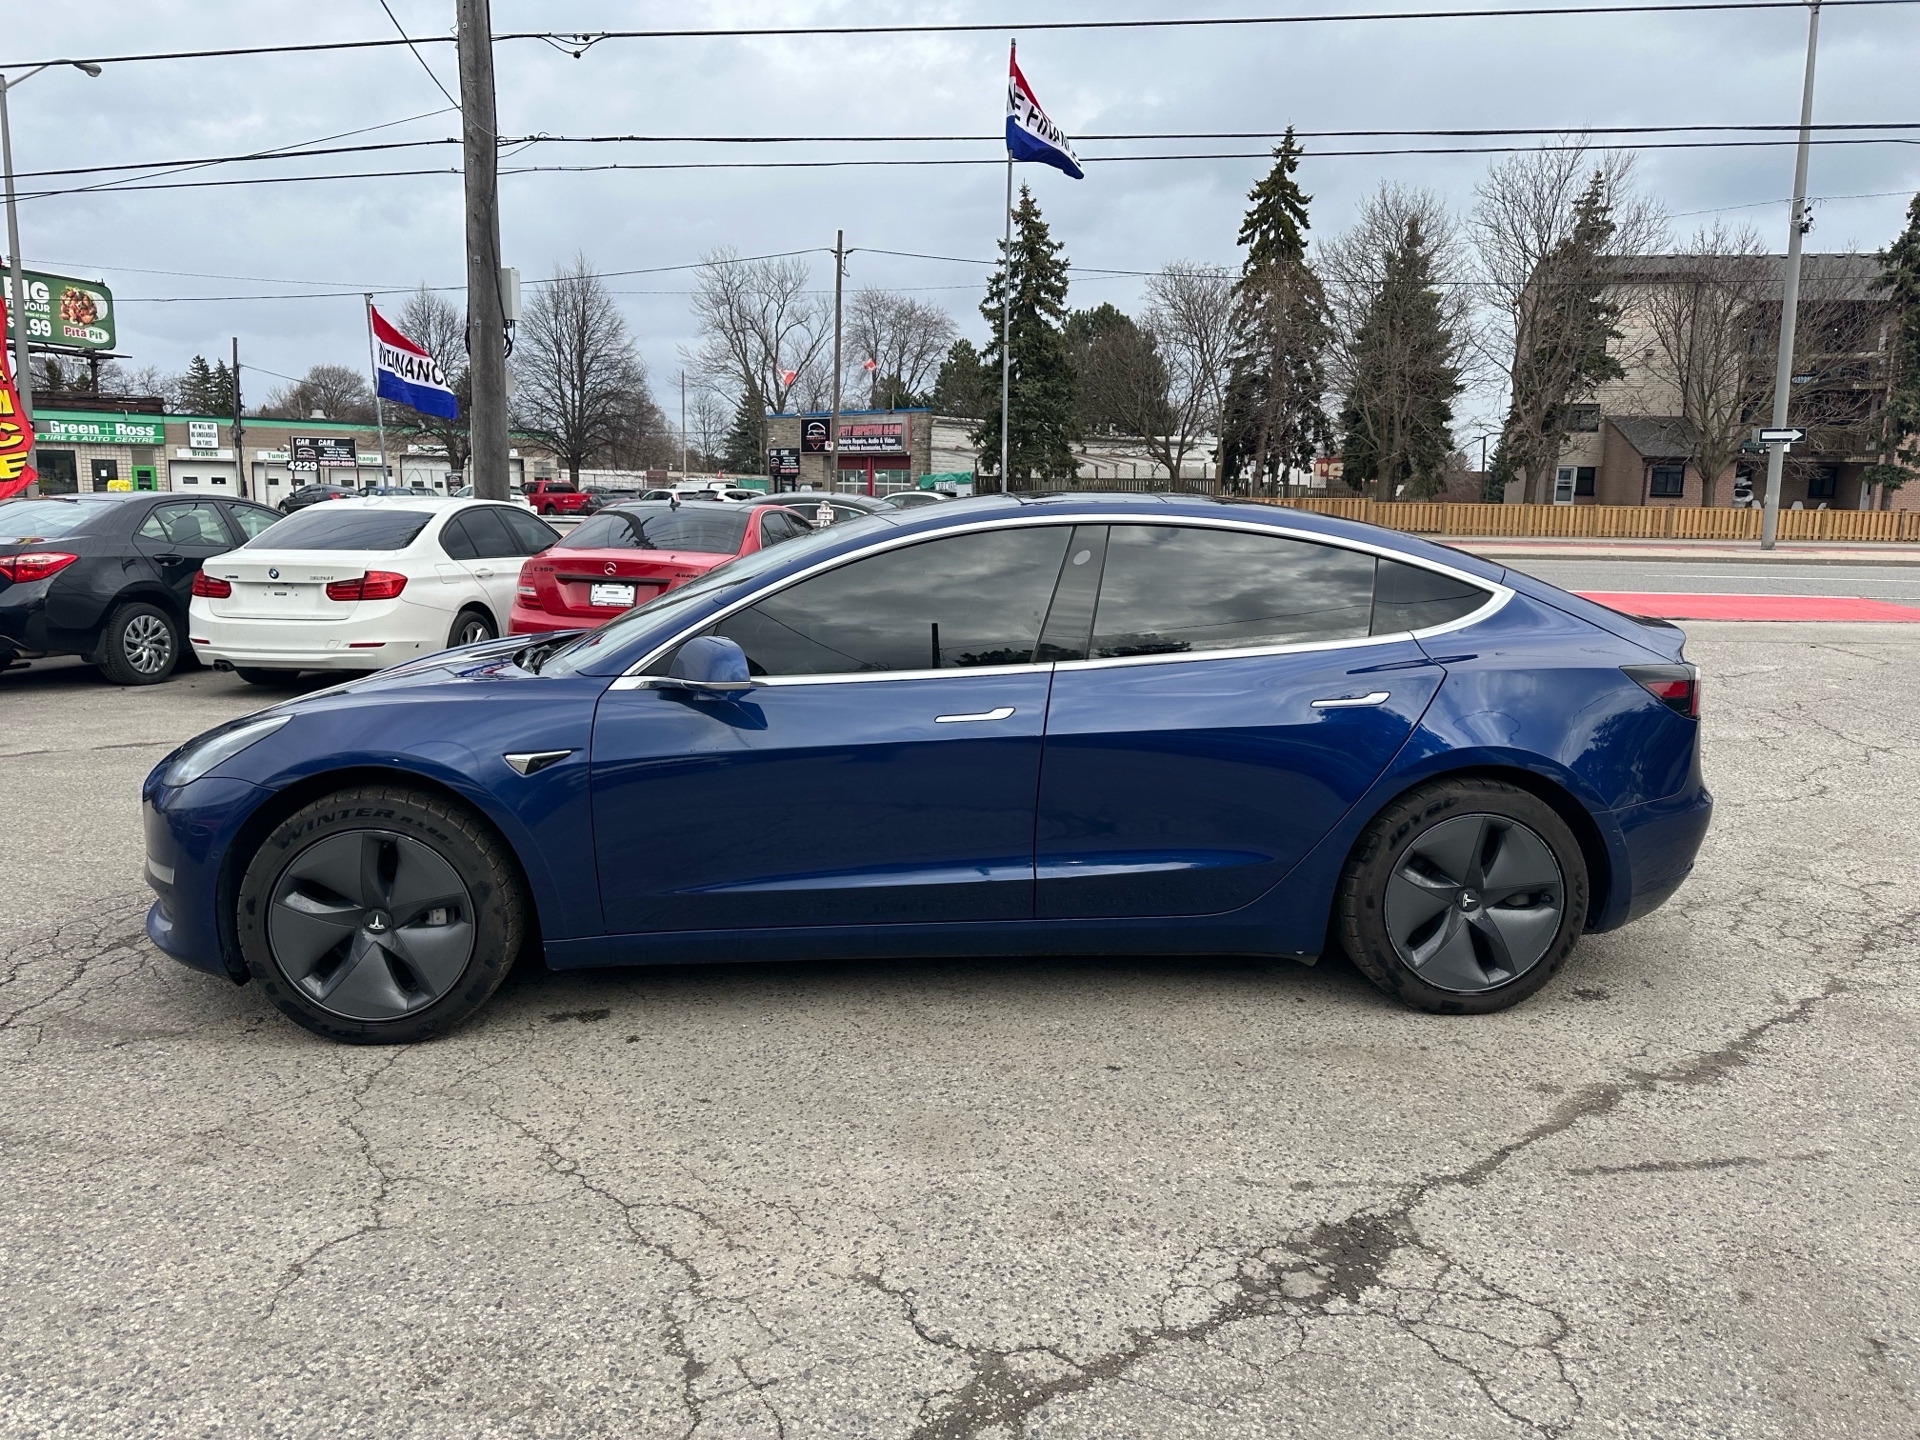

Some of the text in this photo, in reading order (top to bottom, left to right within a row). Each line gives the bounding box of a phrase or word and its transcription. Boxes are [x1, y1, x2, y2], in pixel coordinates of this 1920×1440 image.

[6, 299, 50, 313] FLVOUR
[7, 316, 51, 337] $.99
[64, 326, 103, 340] Pita Pit
[288, 462, 317, 471] 4229
[272, 807, 396, 850] WINTER
